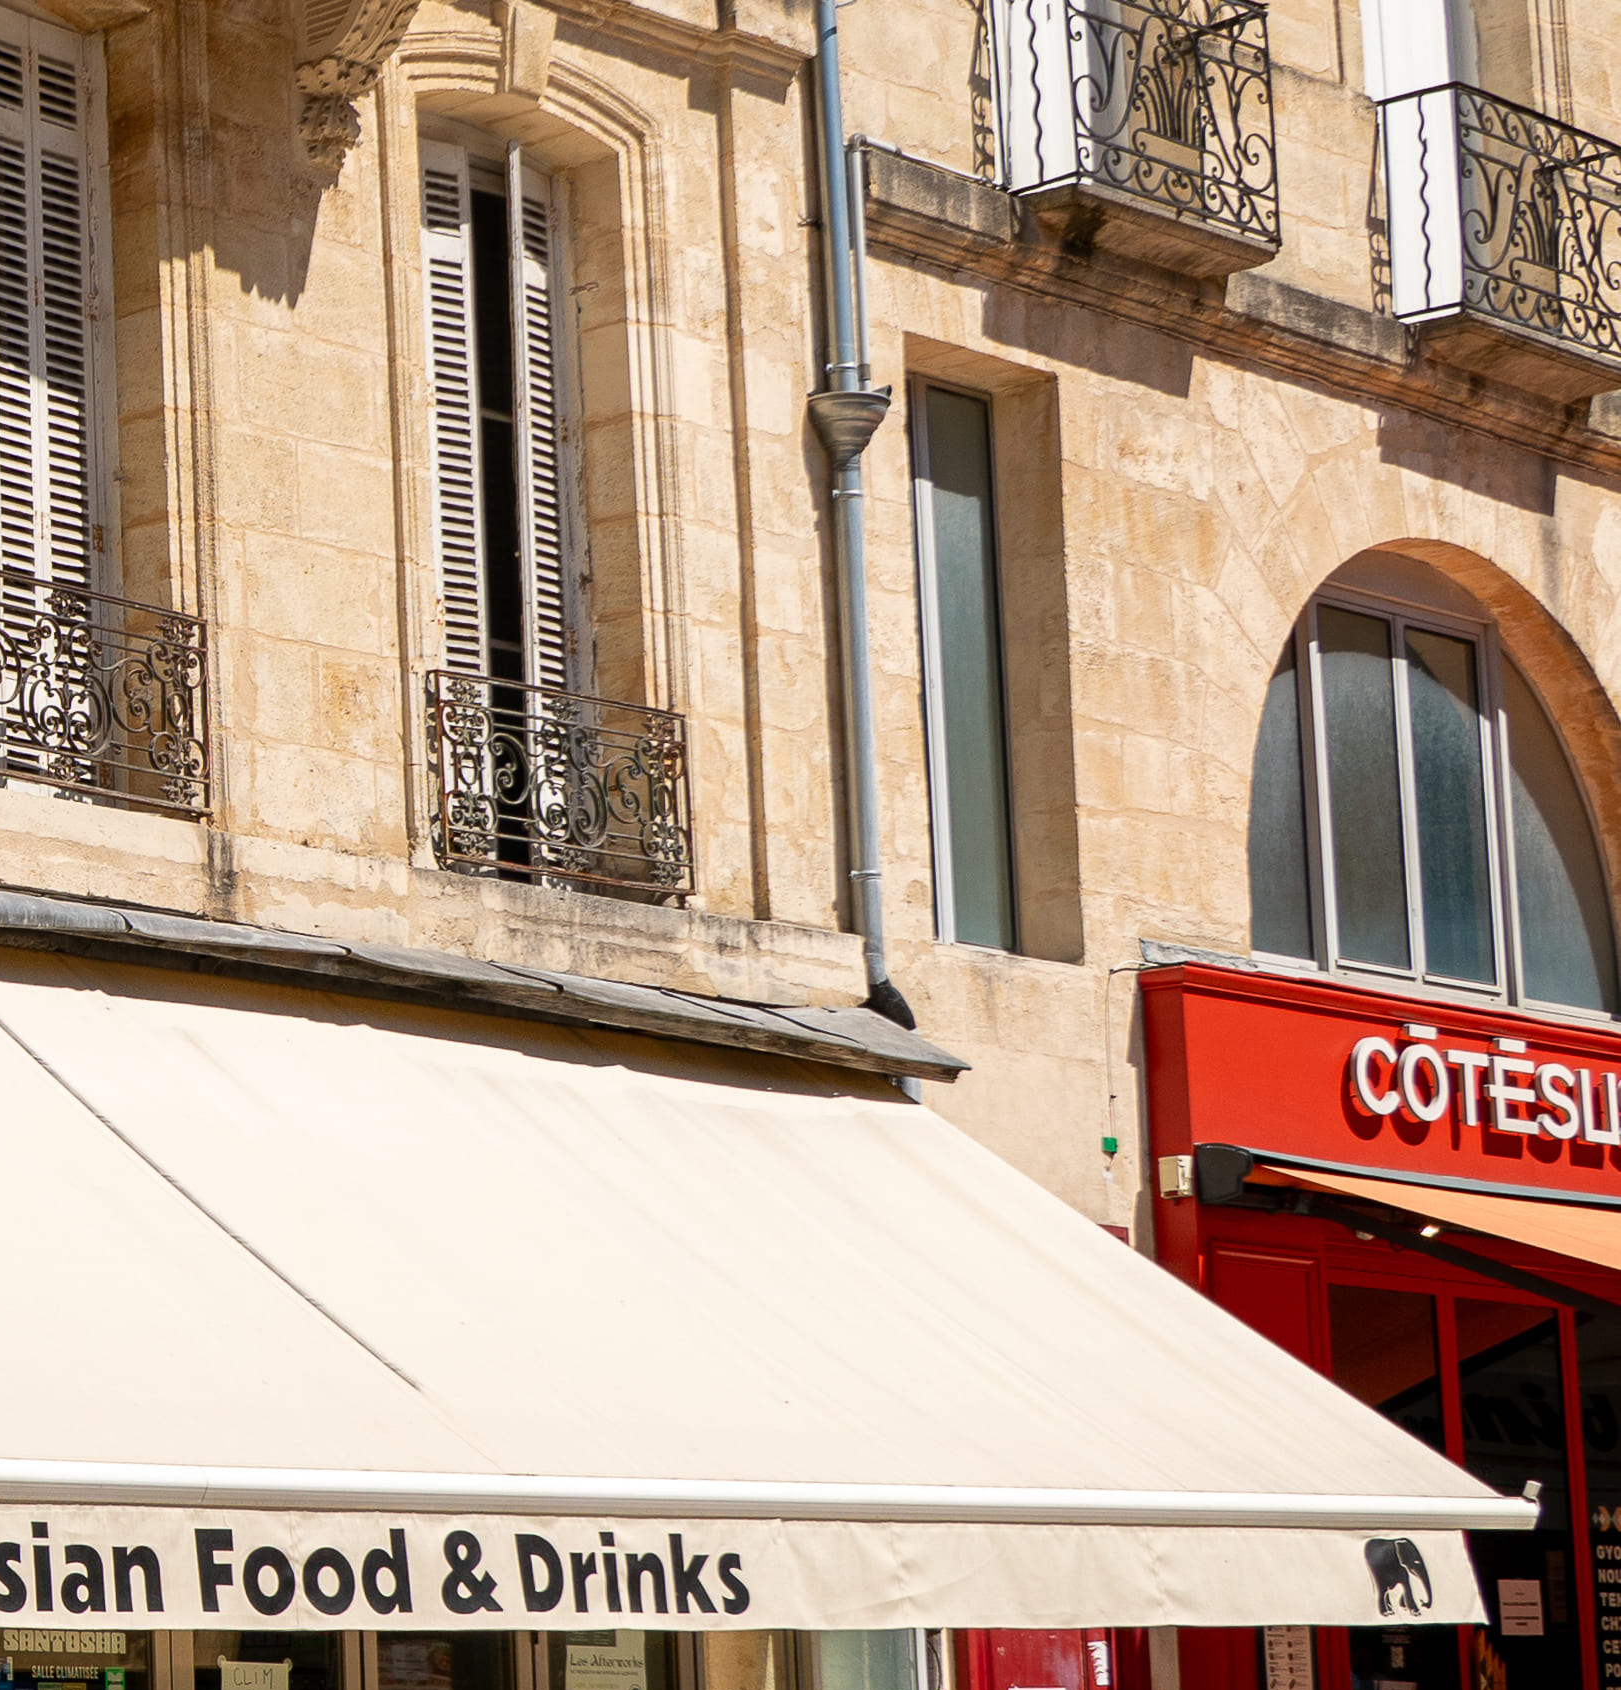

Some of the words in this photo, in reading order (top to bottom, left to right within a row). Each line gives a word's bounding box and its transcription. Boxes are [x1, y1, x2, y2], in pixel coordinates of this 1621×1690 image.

[194, 1527, 414, 1616] Food
[441, 1529, 504, 1616] &
[514, 1531, 750, 1616] Drinks
[3, 1629, 127, 1655] SANTOSHA
[31, 1664, 55, 1679] SALLE
[56, 1664, 99, 1680] CLIMATISÉE
[569, 1653, 587, 1667] Les
[590, 1653, 644, 1669] Afterworks
[233, 1667, 273, 1690] CLIM
